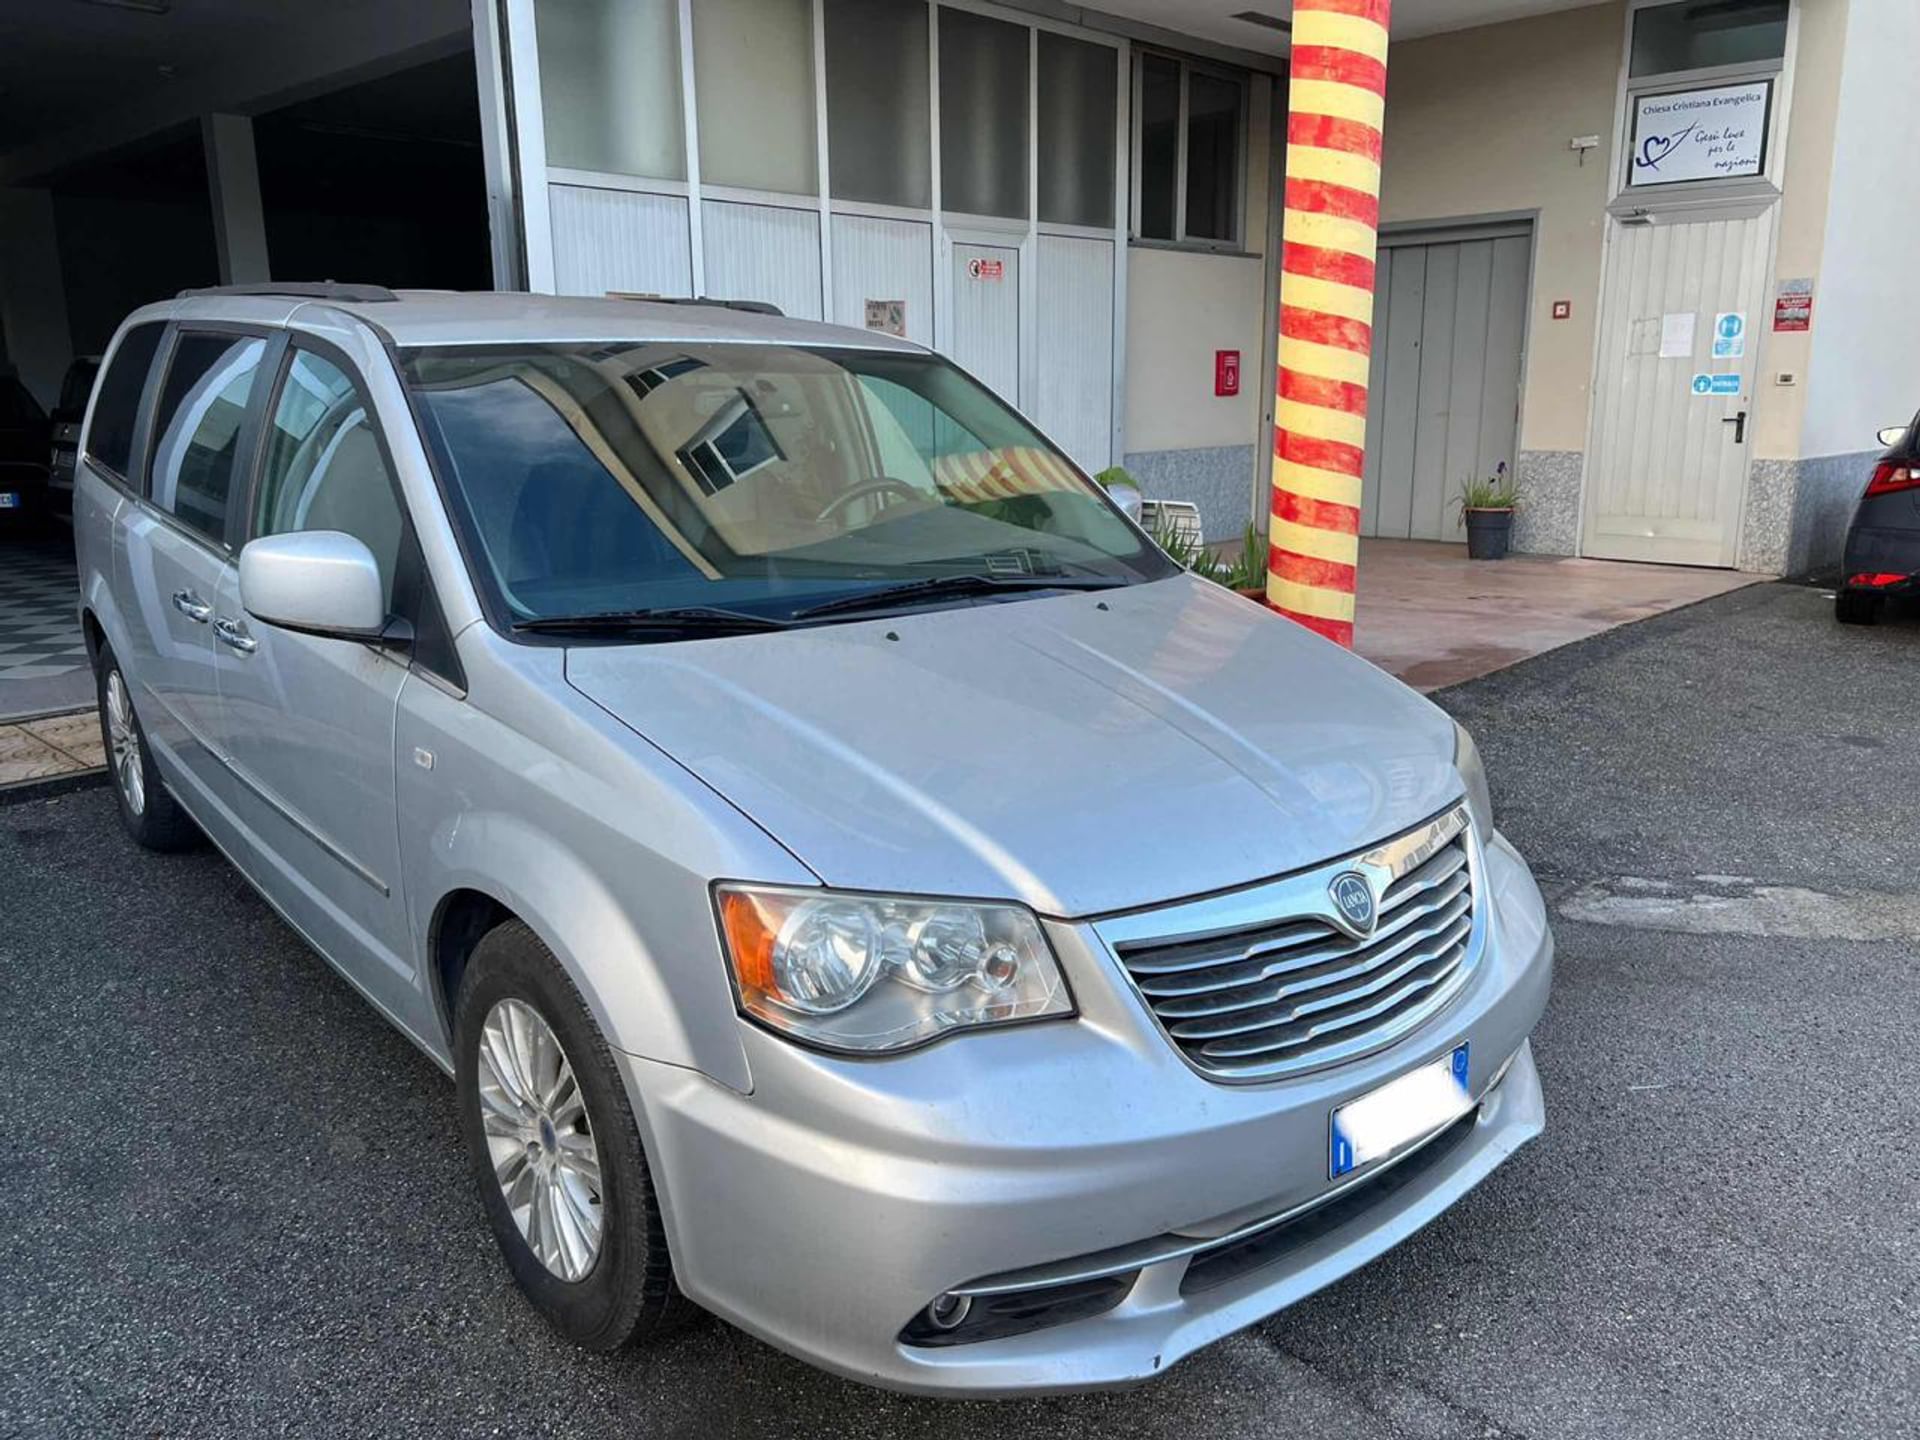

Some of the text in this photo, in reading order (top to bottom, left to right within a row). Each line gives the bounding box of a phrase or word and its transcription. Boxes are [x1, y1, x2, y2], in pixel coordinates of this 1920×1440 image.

[1643, 93, 1761, 115] Chiesa Cristiana Evangelica
[1723, 127, 1744, 139] luce
[1707, 141, 1735, 157] per le
[1713, 155, 1758, 172] nazioni
